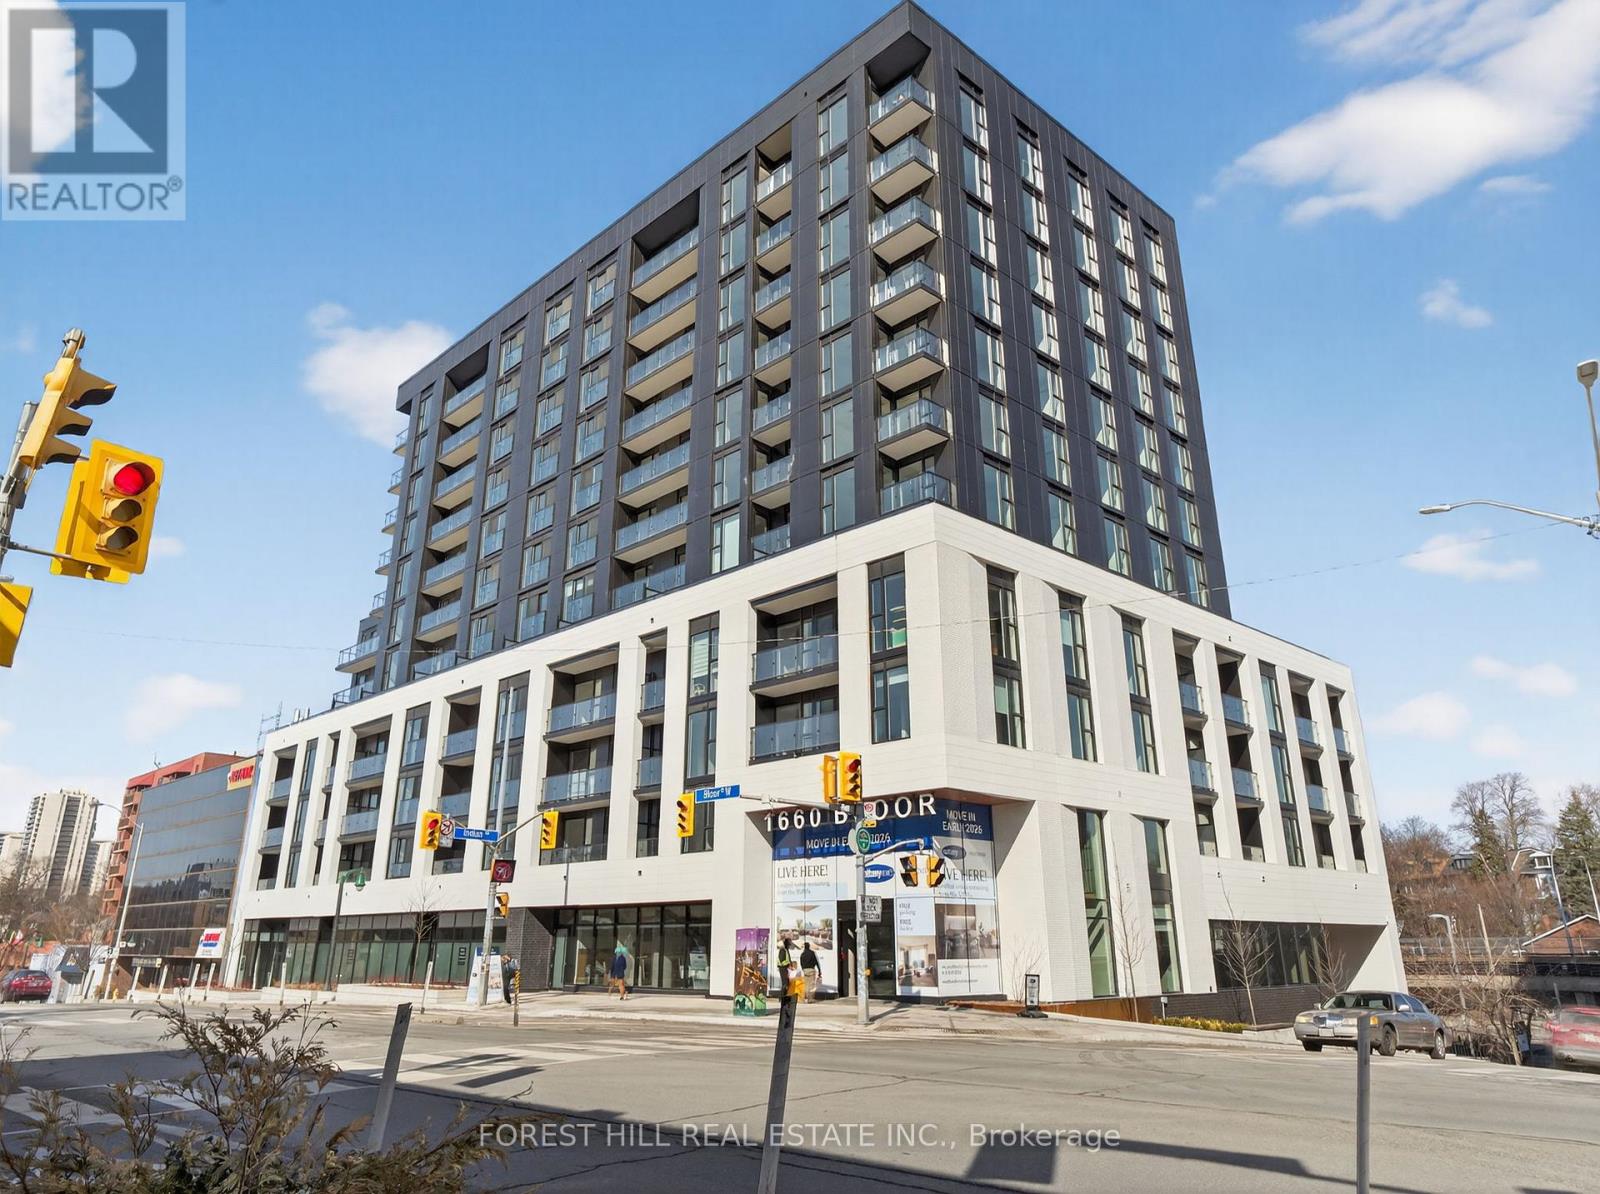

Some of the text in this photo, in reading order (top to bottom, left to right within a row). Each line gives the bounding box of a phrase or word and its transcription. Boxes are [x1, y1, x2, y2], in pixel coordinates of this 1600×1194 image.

[703, 789, 720, 799] Bloor
[764, 794, 936, 832] 1660 BOOR
[946, 809, 976, 822] MOVE IN
[965, 823, 983, 835] 2026
[806, 838, 830, 849] MOVE
[831, 836, 840, 847] IN
[777, 864, 828, 879] LIVE HERE!
[961, 868, 987, 882] HERE!
